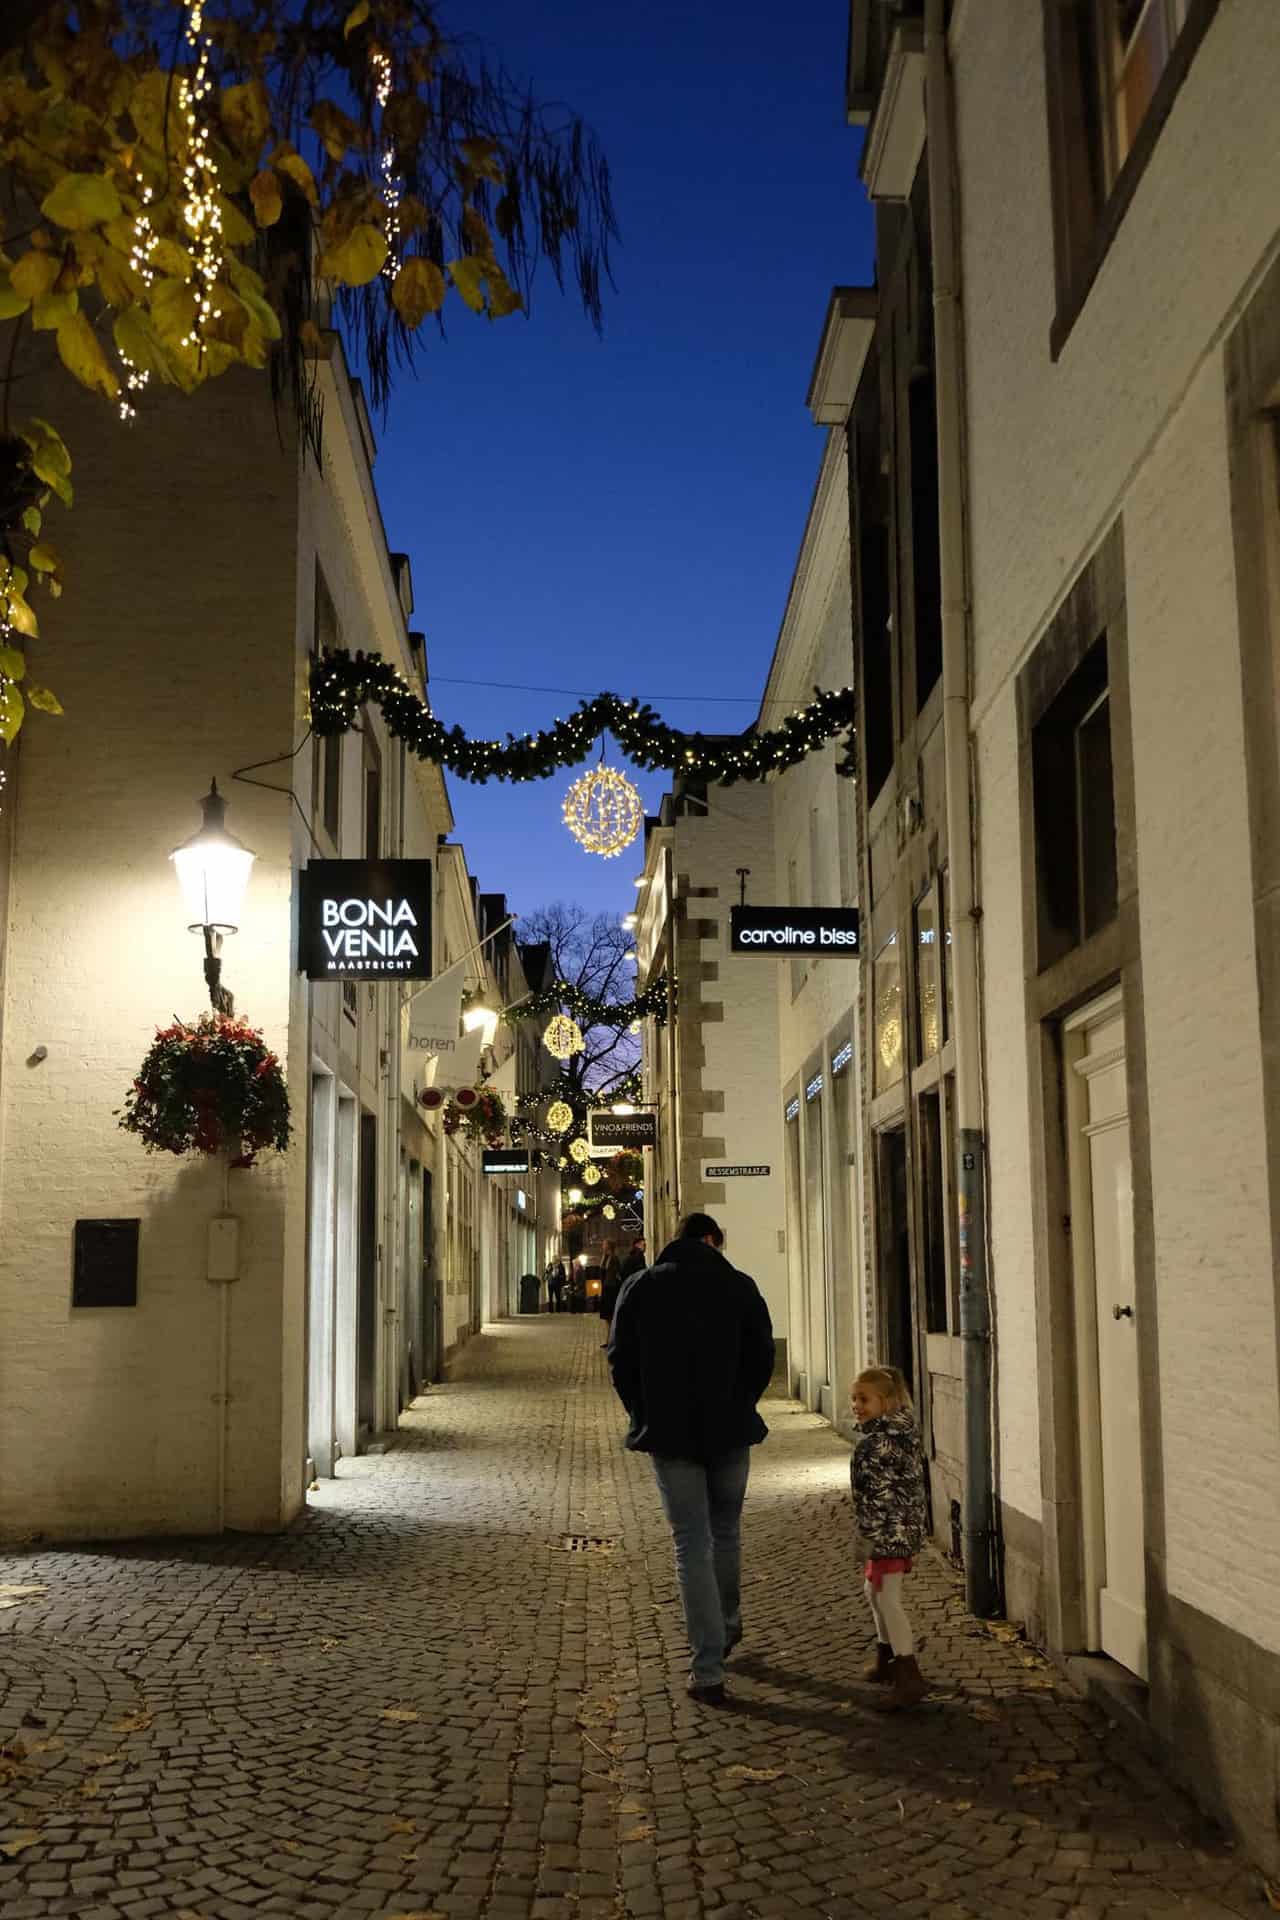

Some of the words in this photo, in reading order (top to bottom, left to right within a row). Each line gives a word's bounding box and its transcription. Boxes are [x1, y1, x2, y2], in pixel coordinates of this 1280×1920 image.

[323, 898, 417, 926] BONA
[322, 929, 419, 957] VENIA
[739, 926, 816, 945] caroline
[820, 927, 857, 945] biss
[327, 961, 412, 969] MAASTRICHT
